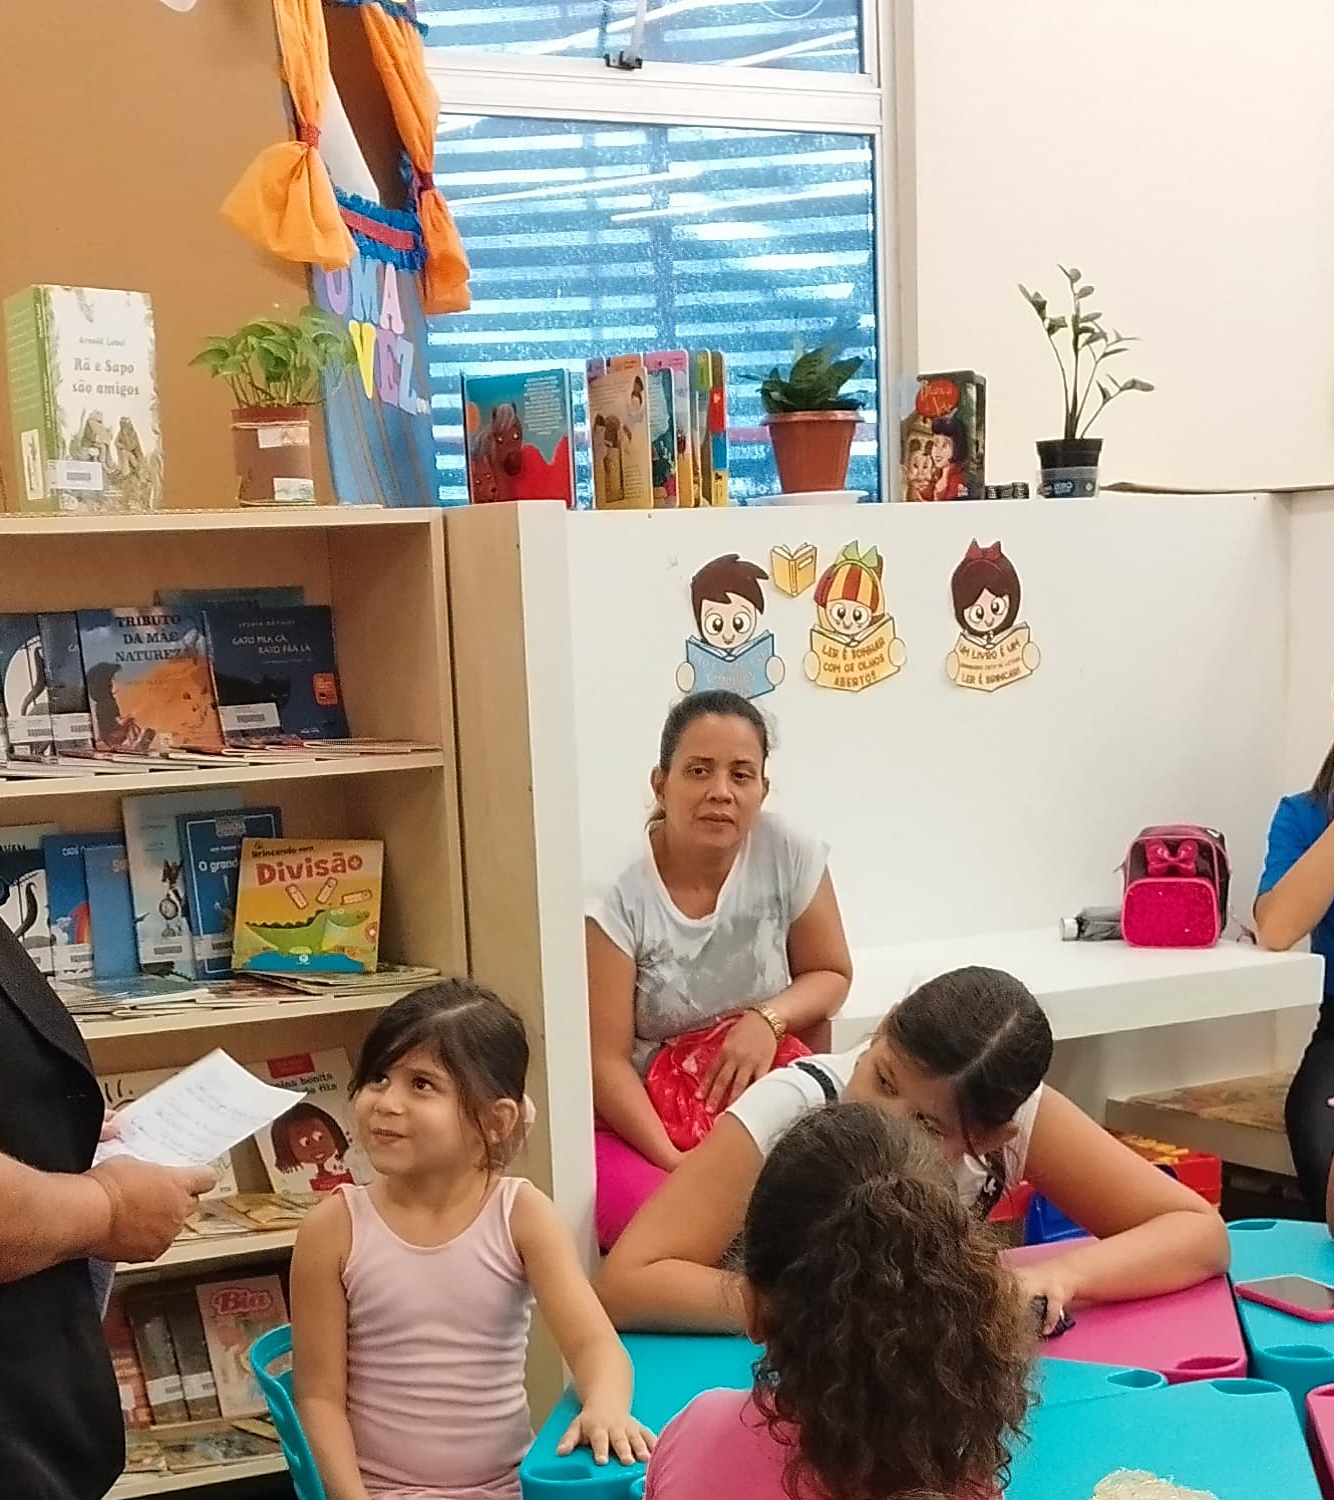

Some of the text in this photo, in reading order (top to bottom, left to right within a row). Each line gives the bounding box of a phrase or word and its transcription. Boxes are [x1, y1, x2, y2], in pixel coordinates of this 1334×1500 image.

[325, 248, 405, 334] UMA
[74, 357, 135, 376] Rã e Sapo
[72, 379, 140, 398] são amigos
[114, 614, 181, 627] TRIBUTO
[123, 633, 143, 645] DA
[822, 644, 839, 658] LER
[823, 662, 841, 673] COM
[256, 852, 364, 886] Divisão
